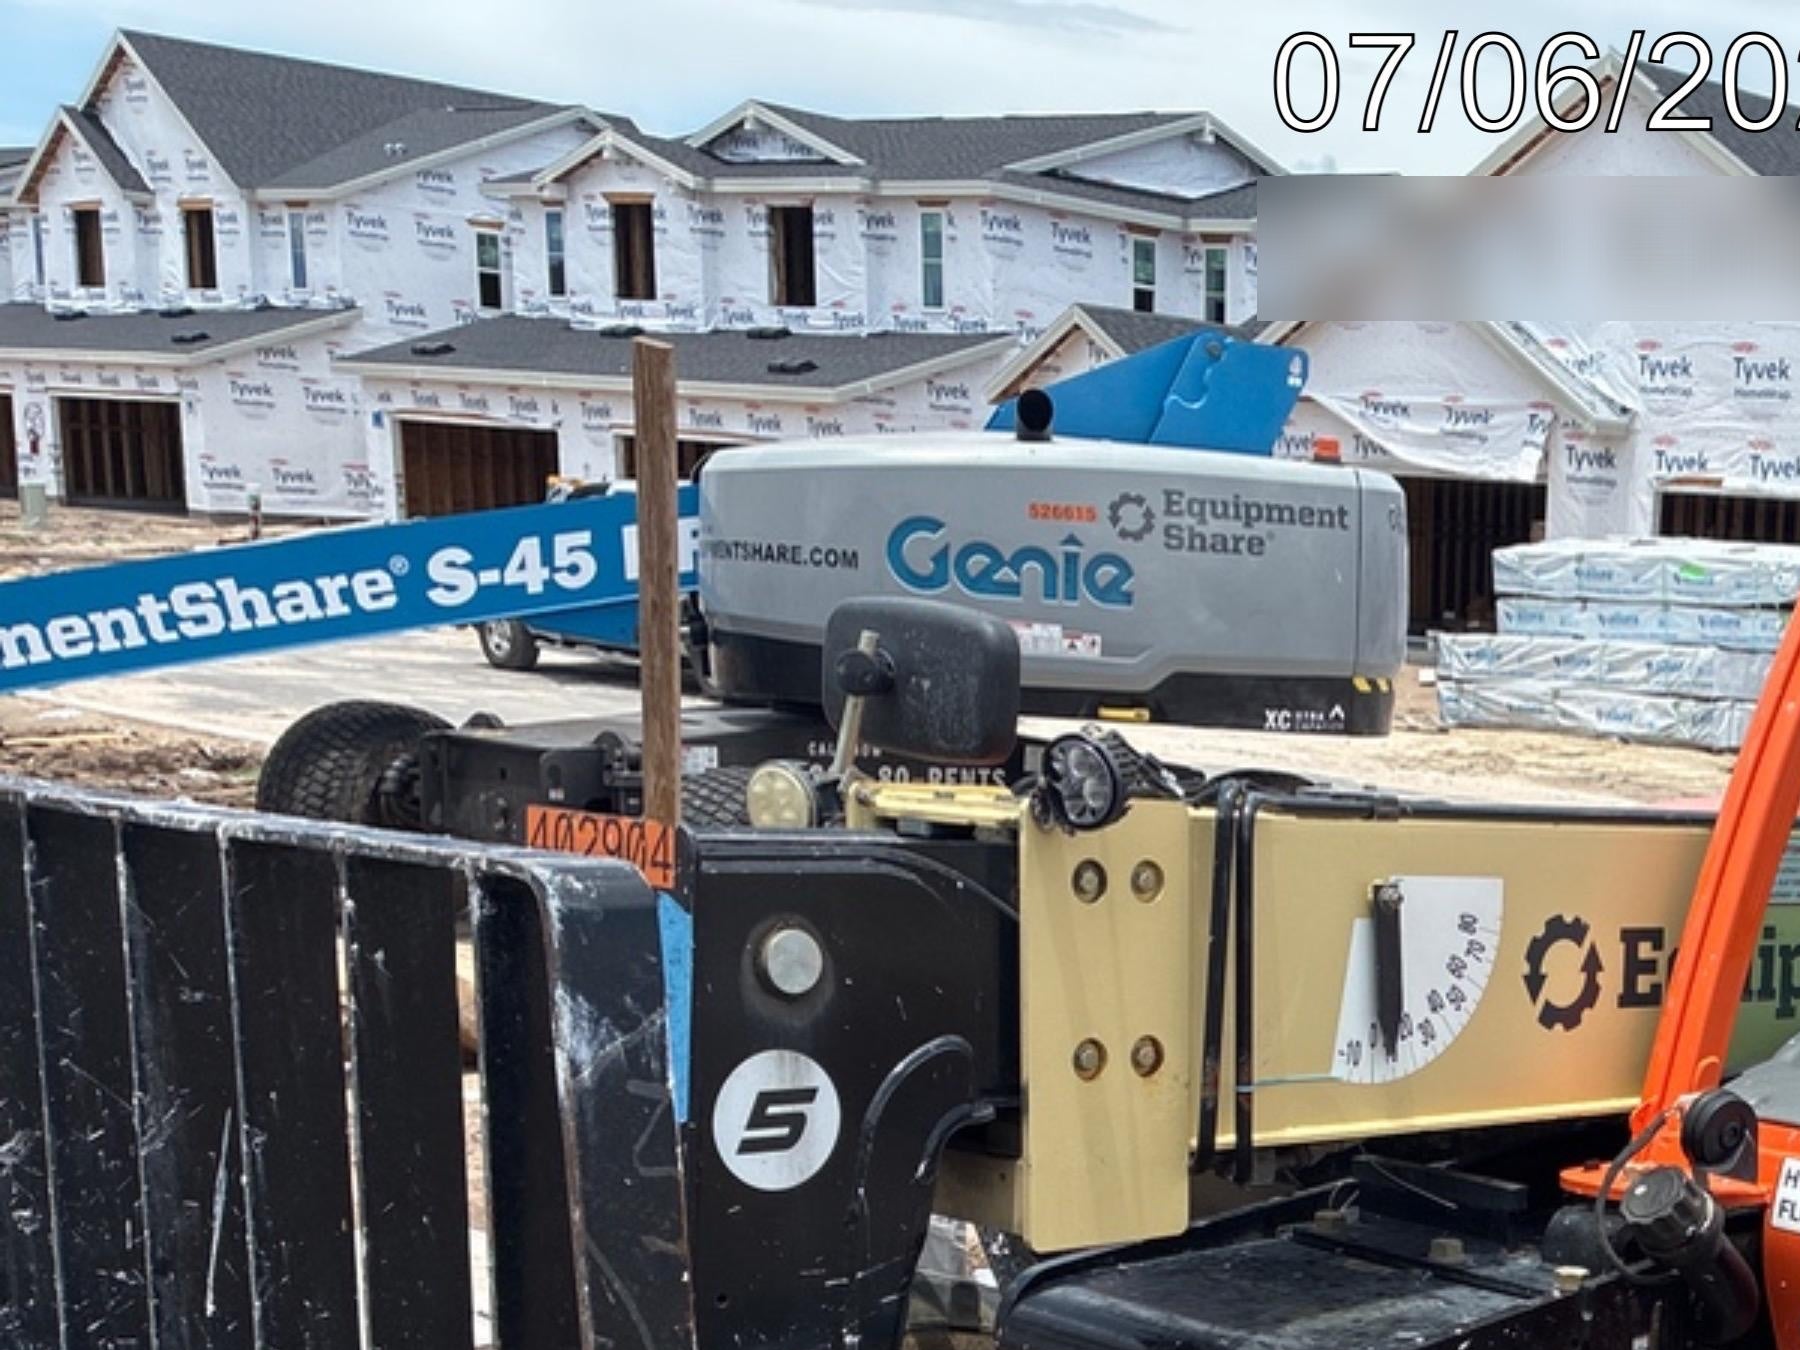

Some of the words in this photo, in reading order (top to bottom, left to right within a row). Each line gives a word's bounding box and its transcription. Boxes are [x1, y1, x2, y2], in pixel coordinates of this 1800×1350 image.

[346, 211, 388, 230] Tyvek
[415, 221, 455, 240] Tyvek
[980, 210, 1022, 232] Tyvek
[1051, 221, 1092, 245] Tyvek
[386, 300, 428, 318] Tyvek
[1639, 355, 1693, 381] Tyvek
[1733, 357, 1791, 384] Tyvek
[230, 381, 273, 397] Tyvek
[303, 387, 345, 403] Tyvek
[926, 381, 970, 400] Tyvek
[1363, 396, 1411, 417] Tyvek
[1565, 445, 1616, 469] Tyvek
[1656, 451, 1709, 472] Tyvek
[200, 462, 241, 480] Tyvek
[273, 467, 314, 484] Tyvek
[1162, 489, 1350, 530] Equipment
[426, 529, 598, 606] S-45
[887, 515, 1135, 607] Genie
[1264, 708, 1291, 731] XC
